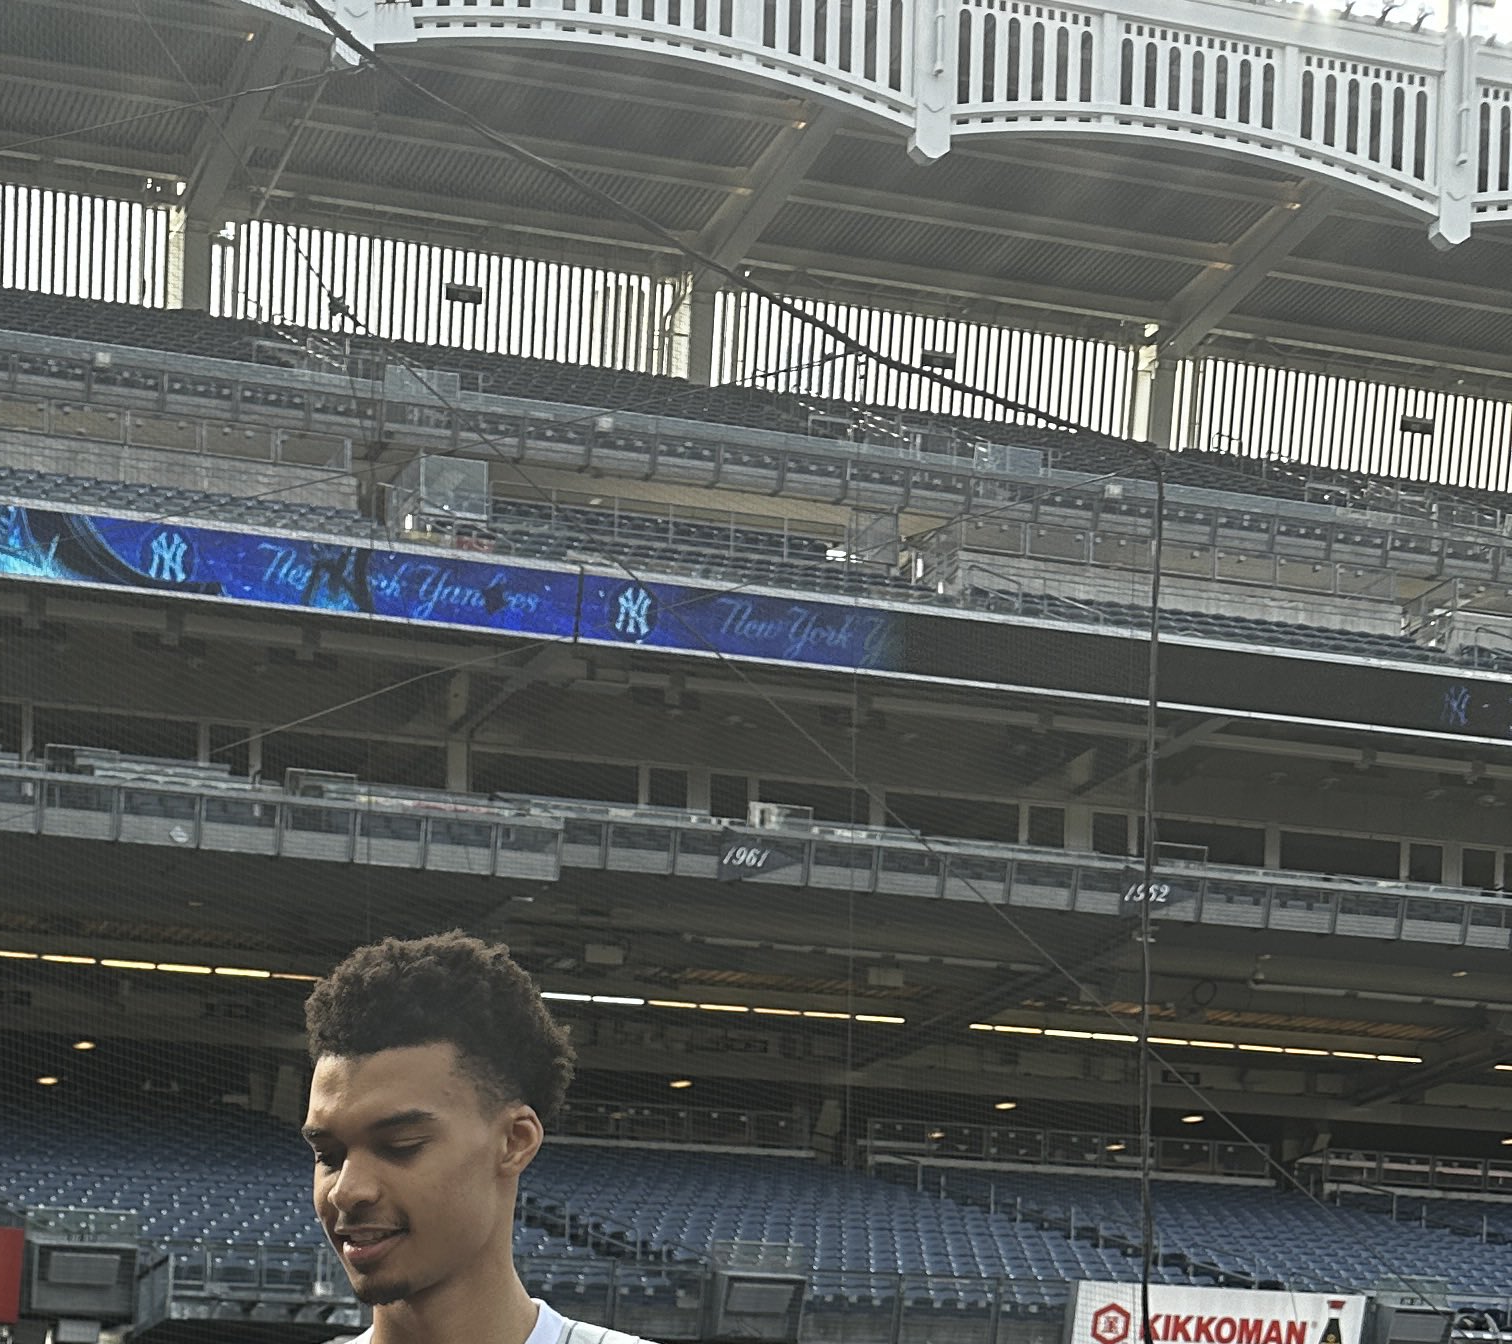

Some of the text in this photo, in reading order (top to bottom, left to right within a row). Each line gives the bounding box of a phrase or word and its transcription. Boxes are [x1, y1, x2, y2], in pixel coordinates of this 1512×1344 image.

[149, 531, 188, 583] NY
[618, 586, 652, 637] NY
[784, 605, 858, 660] York
[723, 846, 770, 867] 1961
